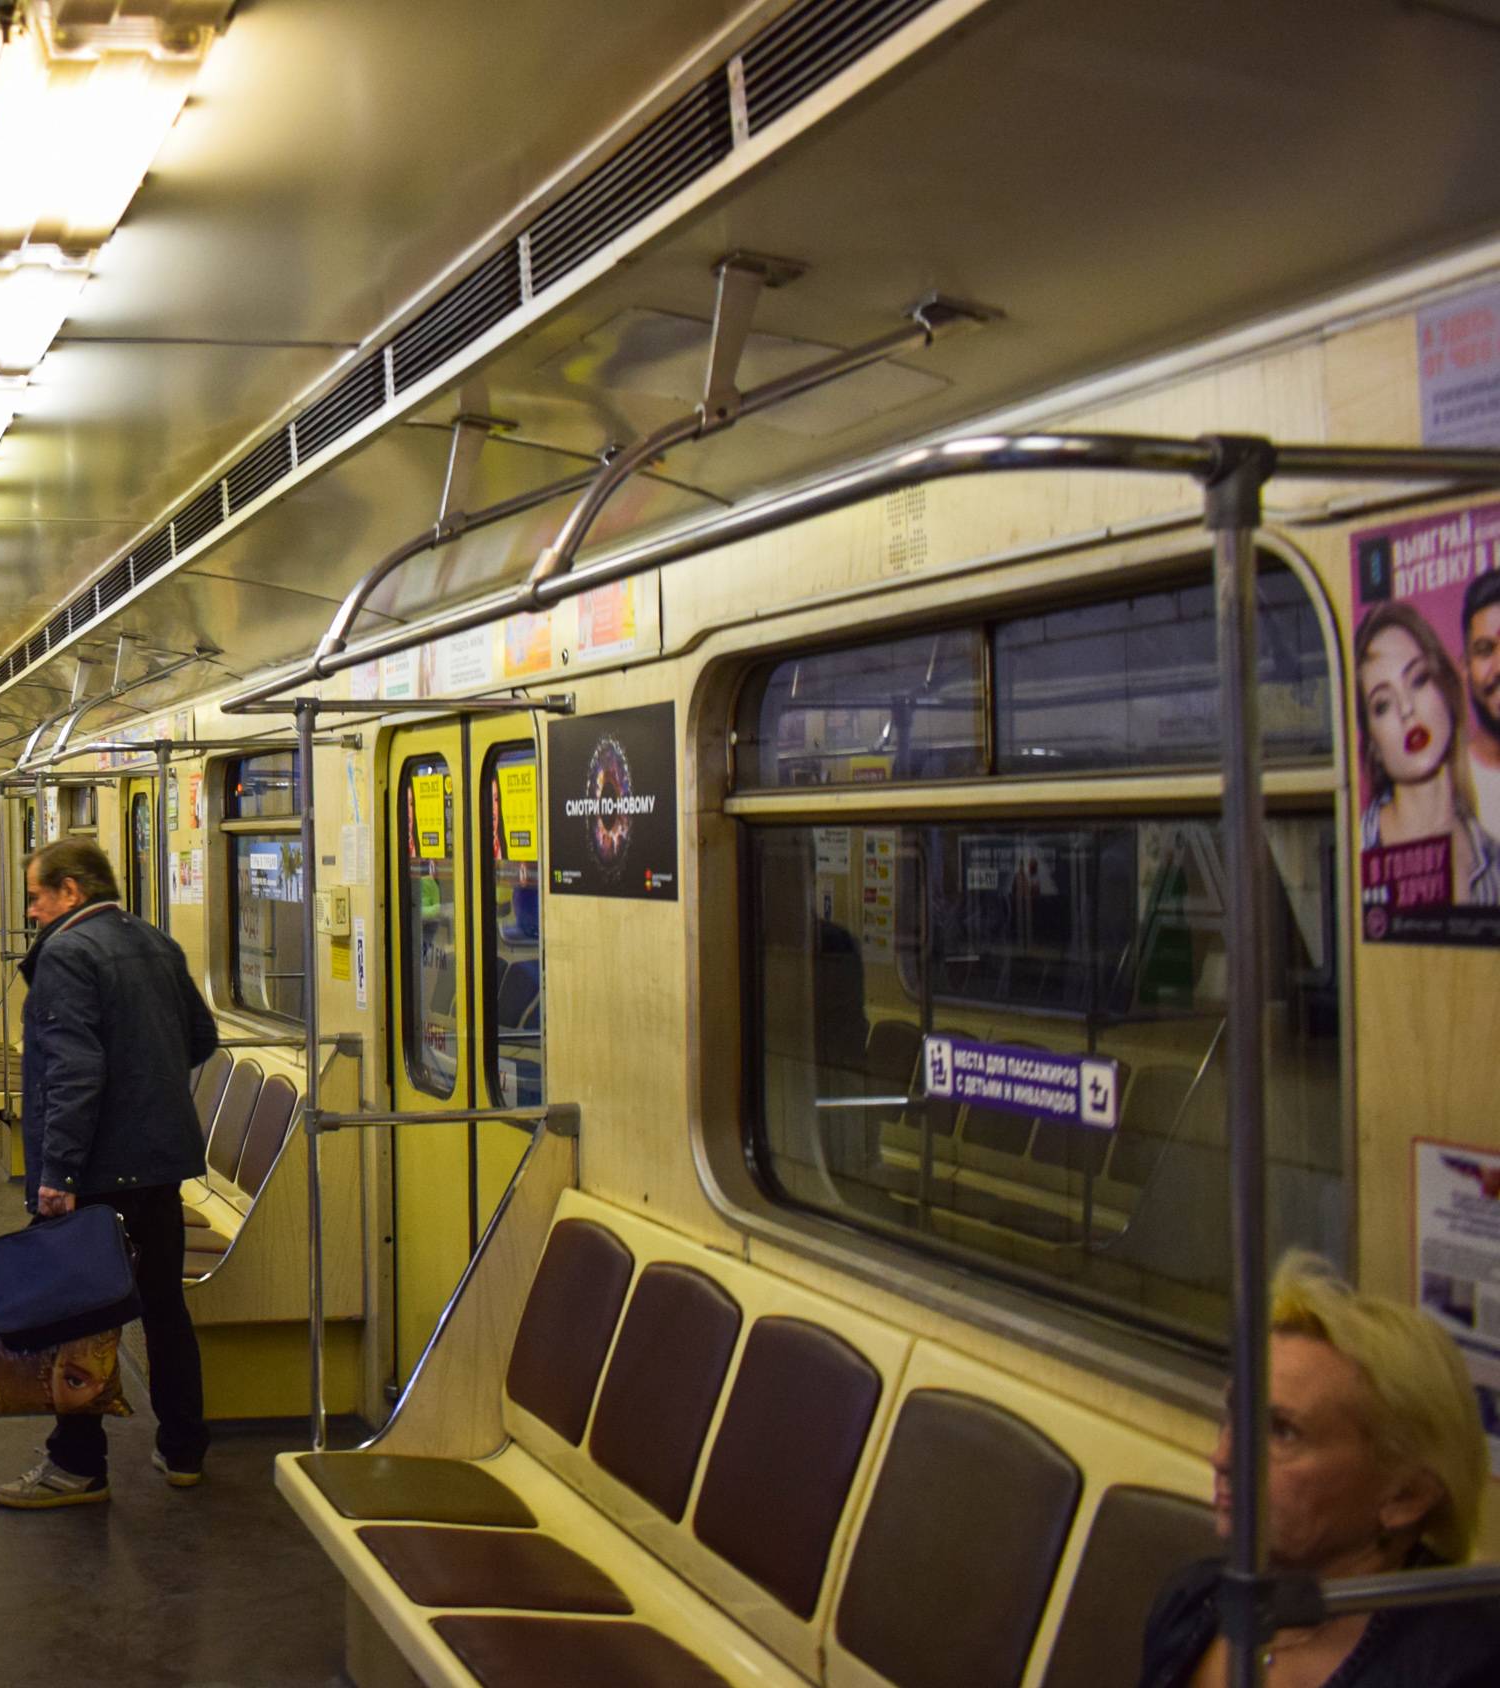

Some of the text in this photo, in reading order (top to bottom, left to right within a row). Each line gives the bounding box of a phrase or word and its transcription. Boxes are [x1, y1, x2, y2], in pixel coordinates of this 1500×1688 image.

[1392, 511, 1472, 566] ВЫИГРАЙ
[1394, 549, 1472, 599] ПУТЕВКУ
[565, 795, 655, 816] СМОТРИ ПО-НОВОМУ
[954, 1049, 1078, 1088] МЕСТА ДЛЯ ПАССАЖИРОВ
[956, 1074, 1077, 1114] С ДЕТЬМИ И ИНВАЛИДОВ
